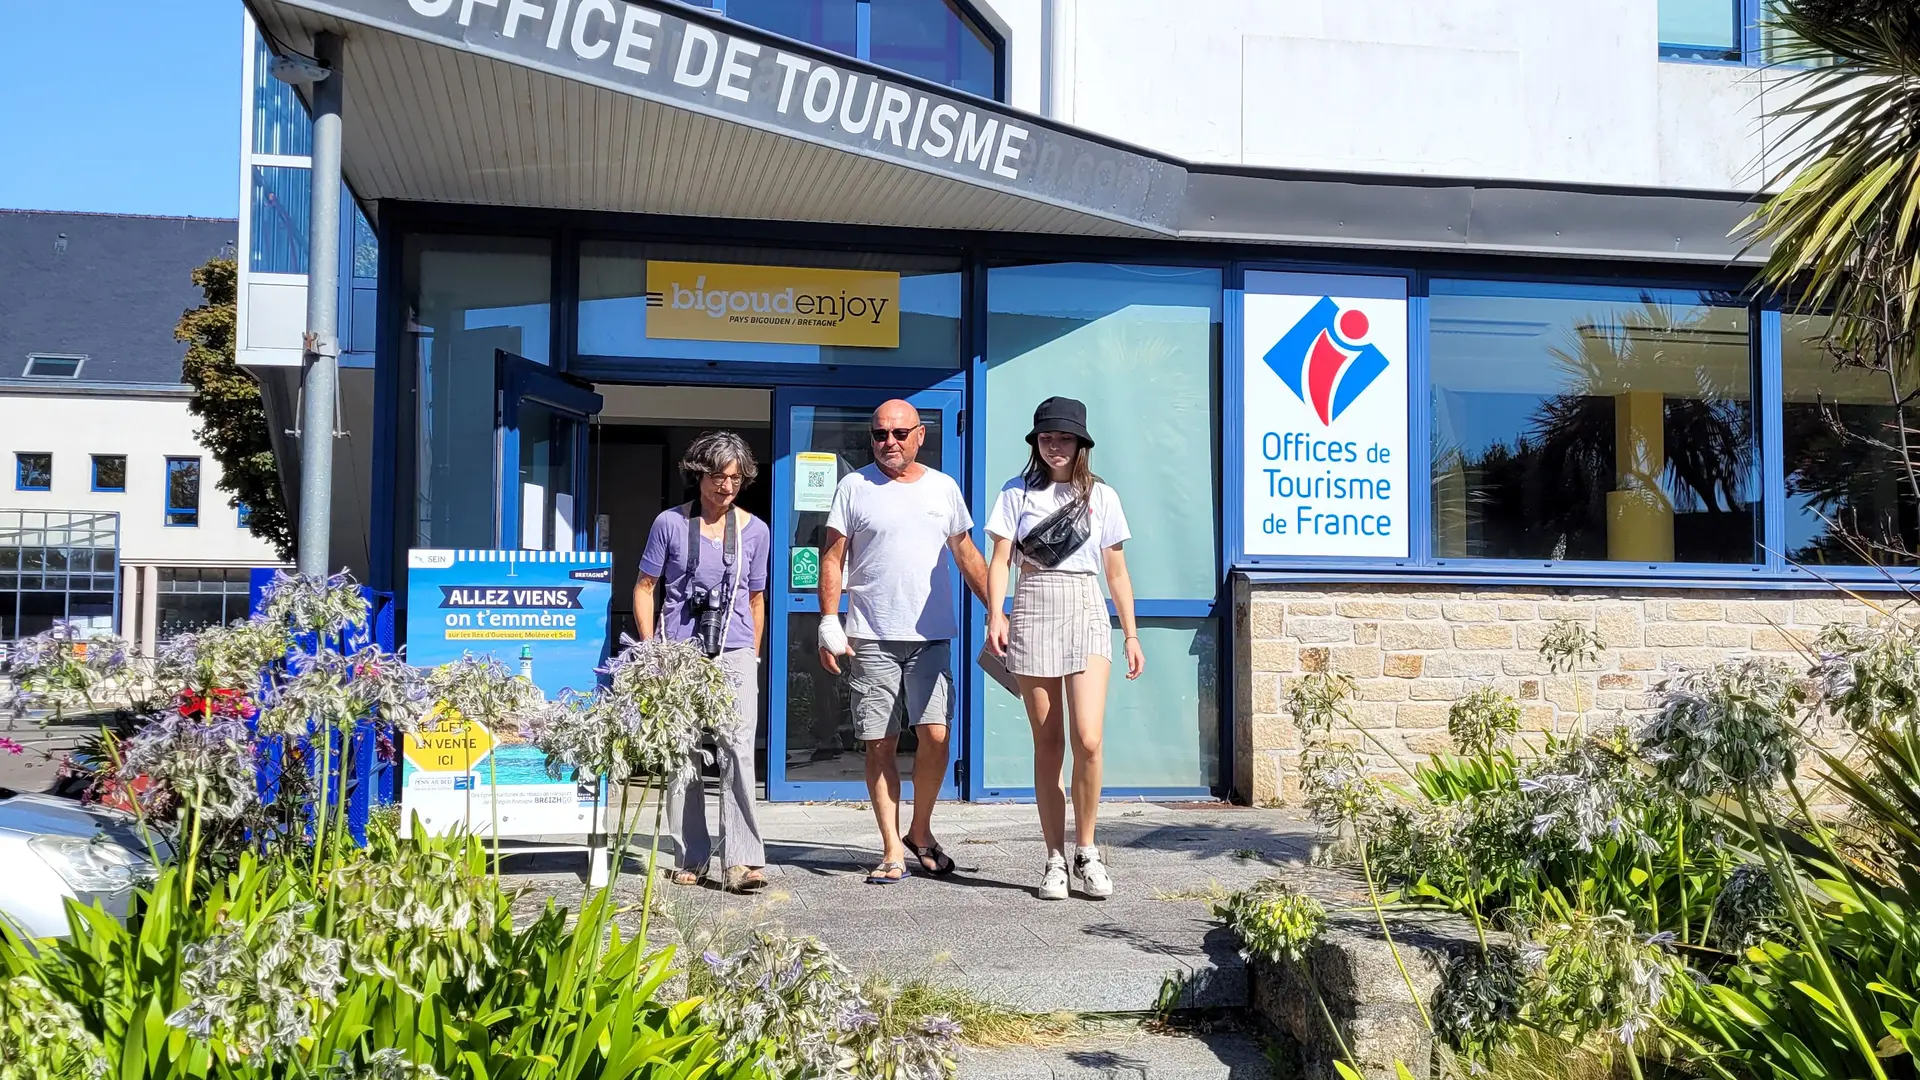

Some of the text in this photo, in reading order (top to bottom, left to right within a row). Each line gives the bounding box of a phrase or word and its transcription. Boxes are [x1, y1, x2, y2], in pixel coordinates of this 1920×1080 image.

[673, 23, 760, 102] DE
[775, 52, 1029, 179] TOURISME
[671, 275, 889, 323] bigoudenjoy
[728, 315, 749, 324] PAYS
[750, 316, 790, 325] BIGOUDEN
[797, 318, 837, 327] BRETAGNE
[1262, 431, 1391, 463] Offices de
[1262, 468, 1391, 500] Tourisme
[1262, 506, 1391, 536] de France
[427, 555, 446, 563] SEIN
[449, 590, 572, 608] ALLEZ VIENS,
[445, 609, 576, 627] on t'emmène
[436, 739, 477, 748] VENTE
[438, 755, 453, 765] ICI
